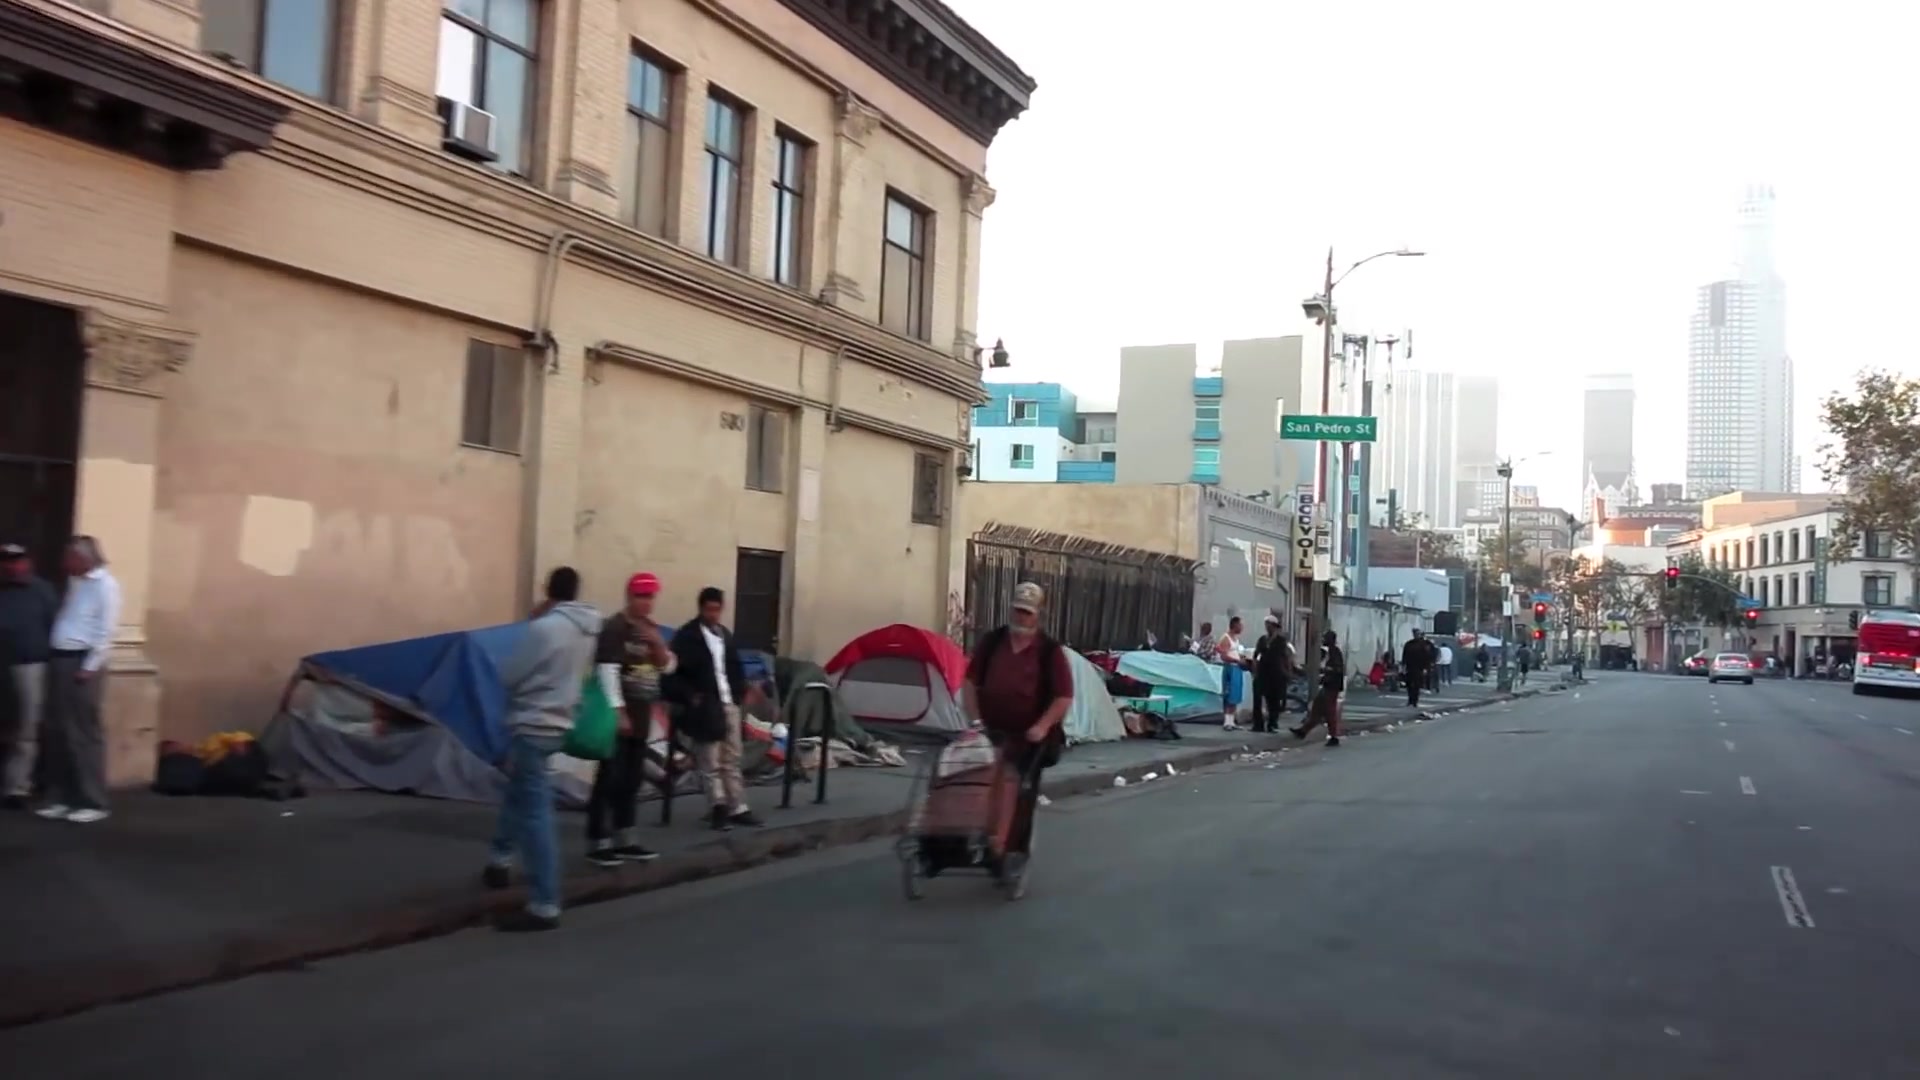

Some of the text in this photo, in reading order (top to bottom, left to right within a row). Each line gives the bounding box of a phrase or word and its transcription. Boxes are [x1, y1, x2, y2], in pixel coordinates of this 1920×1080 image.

[1286, 422, 1371, 435] San Pedro St
